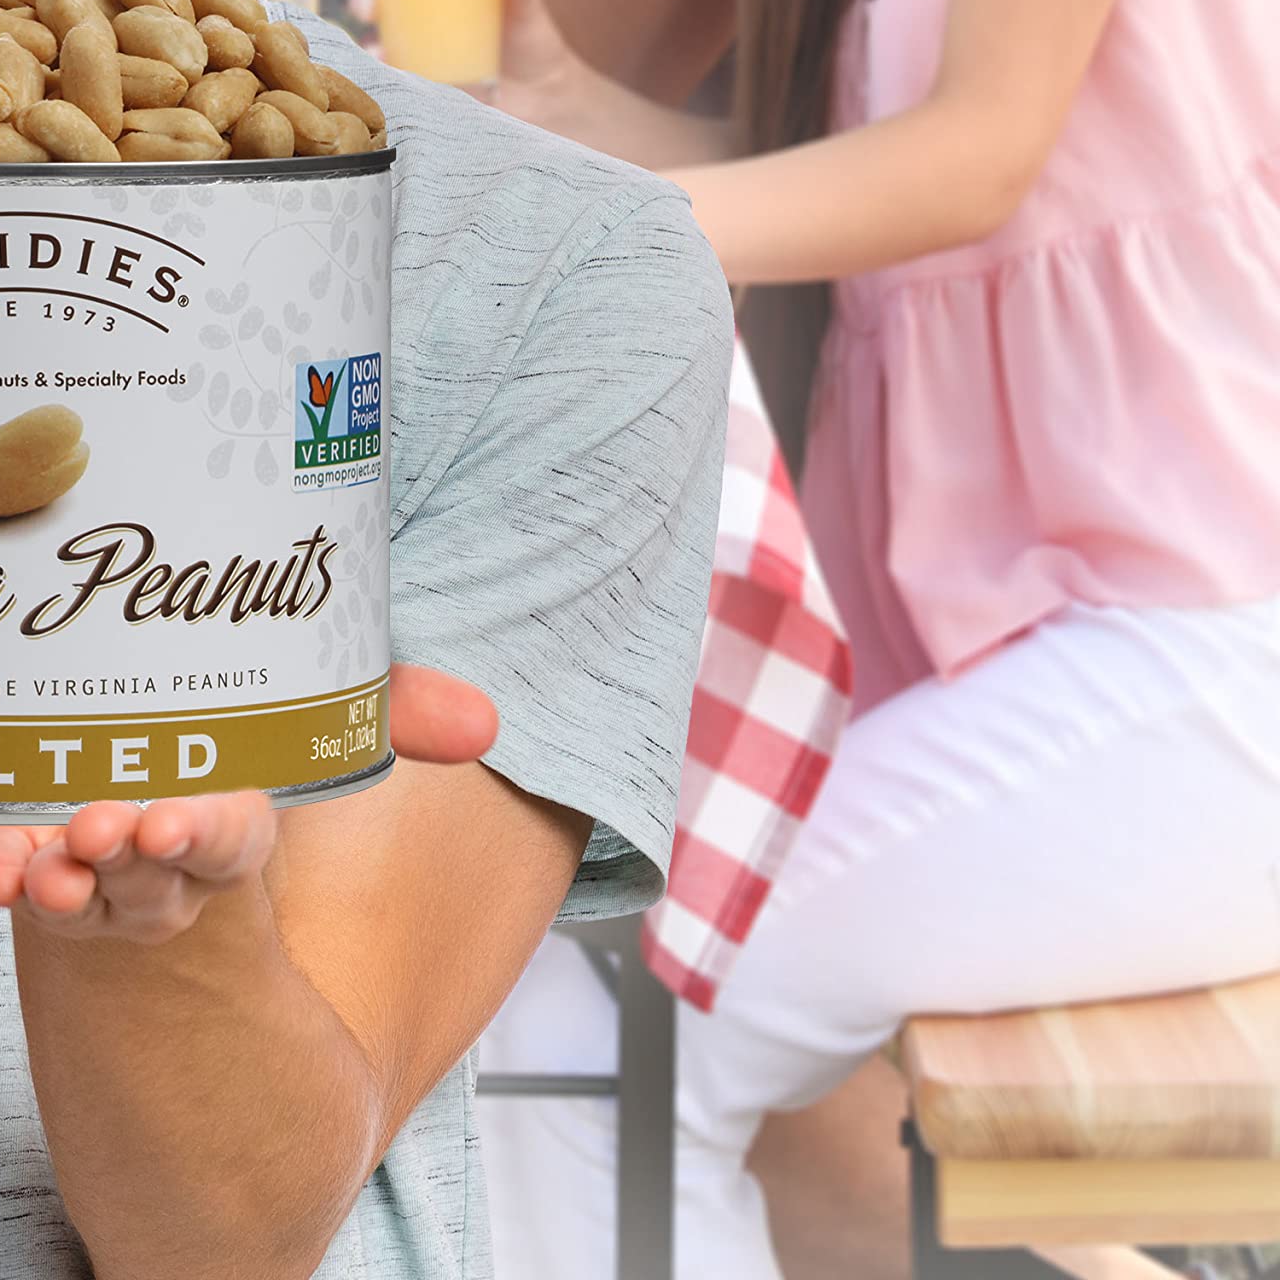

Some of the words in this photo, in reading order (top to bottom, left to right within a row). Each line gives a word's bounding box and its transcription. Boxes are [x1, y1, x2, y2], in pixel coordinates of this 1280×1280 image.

[43, 302, 116, 333] 1973
[34, 372, 48, 388] &
[54, 370, 132, 391] Specialty
[138, 368, 186, 386] Foods
[352, 357, 380, 383] NON
[351, 382, 380, 408] GMO
[351, 407, 380, 431] Project
[301, 434, 380, 465] VERIFIED
[294, 460, 382, 488] nongmoproject.org
[19, 522, 338, 640] Peanuts
[34, 676, 157, 697] VIRGINIA
[173, 668, 269, 692] PEANUTS
[348, 699, 365, 726] NET
[366, 693, 378, 721] WT
[310, 735, 342, 761] 36oz
